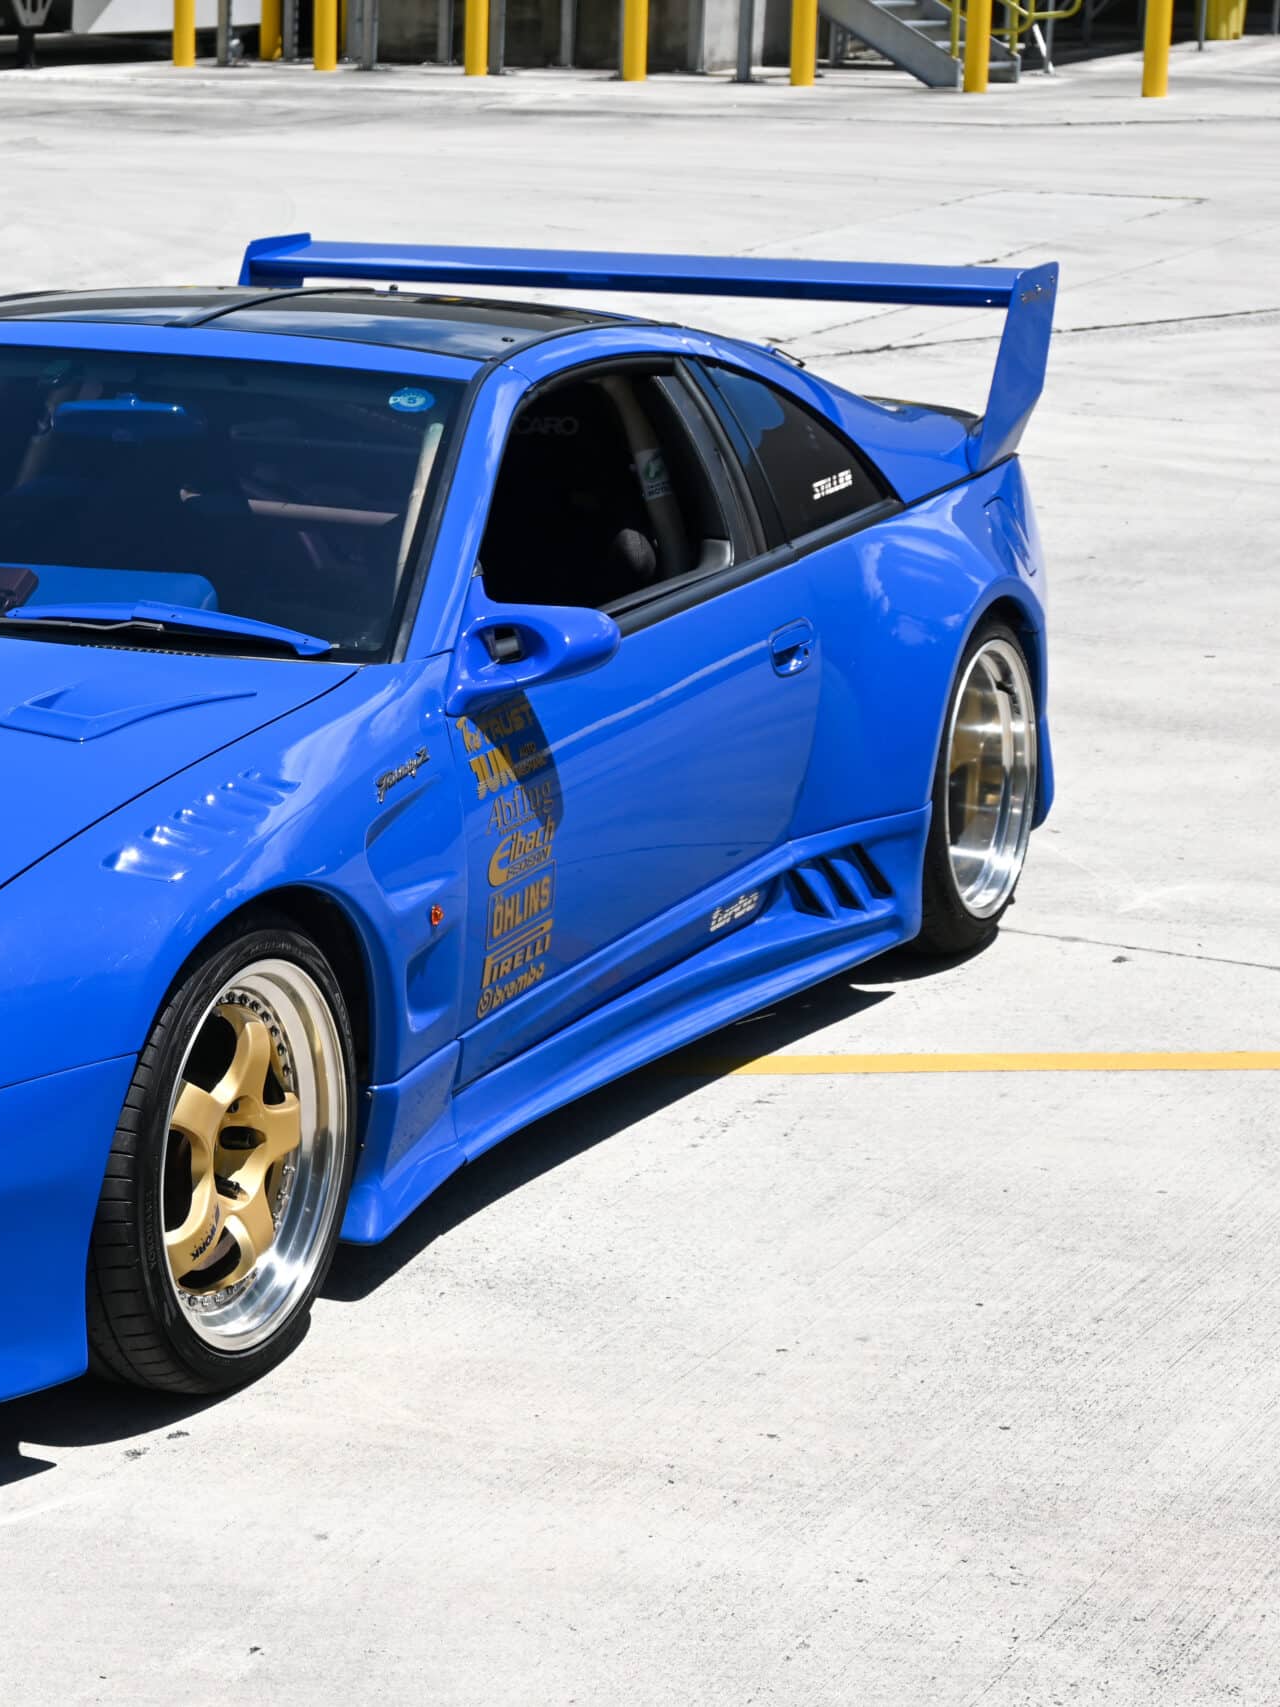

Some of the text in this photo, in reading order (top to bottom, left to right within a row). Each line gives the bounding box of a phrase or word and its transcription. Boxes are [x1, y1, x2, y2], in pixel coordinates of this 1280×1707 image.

[512, 416, 580, 437] CARO
[469, 743, 519, 800] JUN
[485, 781, 553, 835] Abflug
[488, 815, 555, 887] Eibach
[493, 875, 551, 938] ÖHLINS
[482, 918, 553, 989] PIRELLI
[493, 962, 546, 1008] brembo
